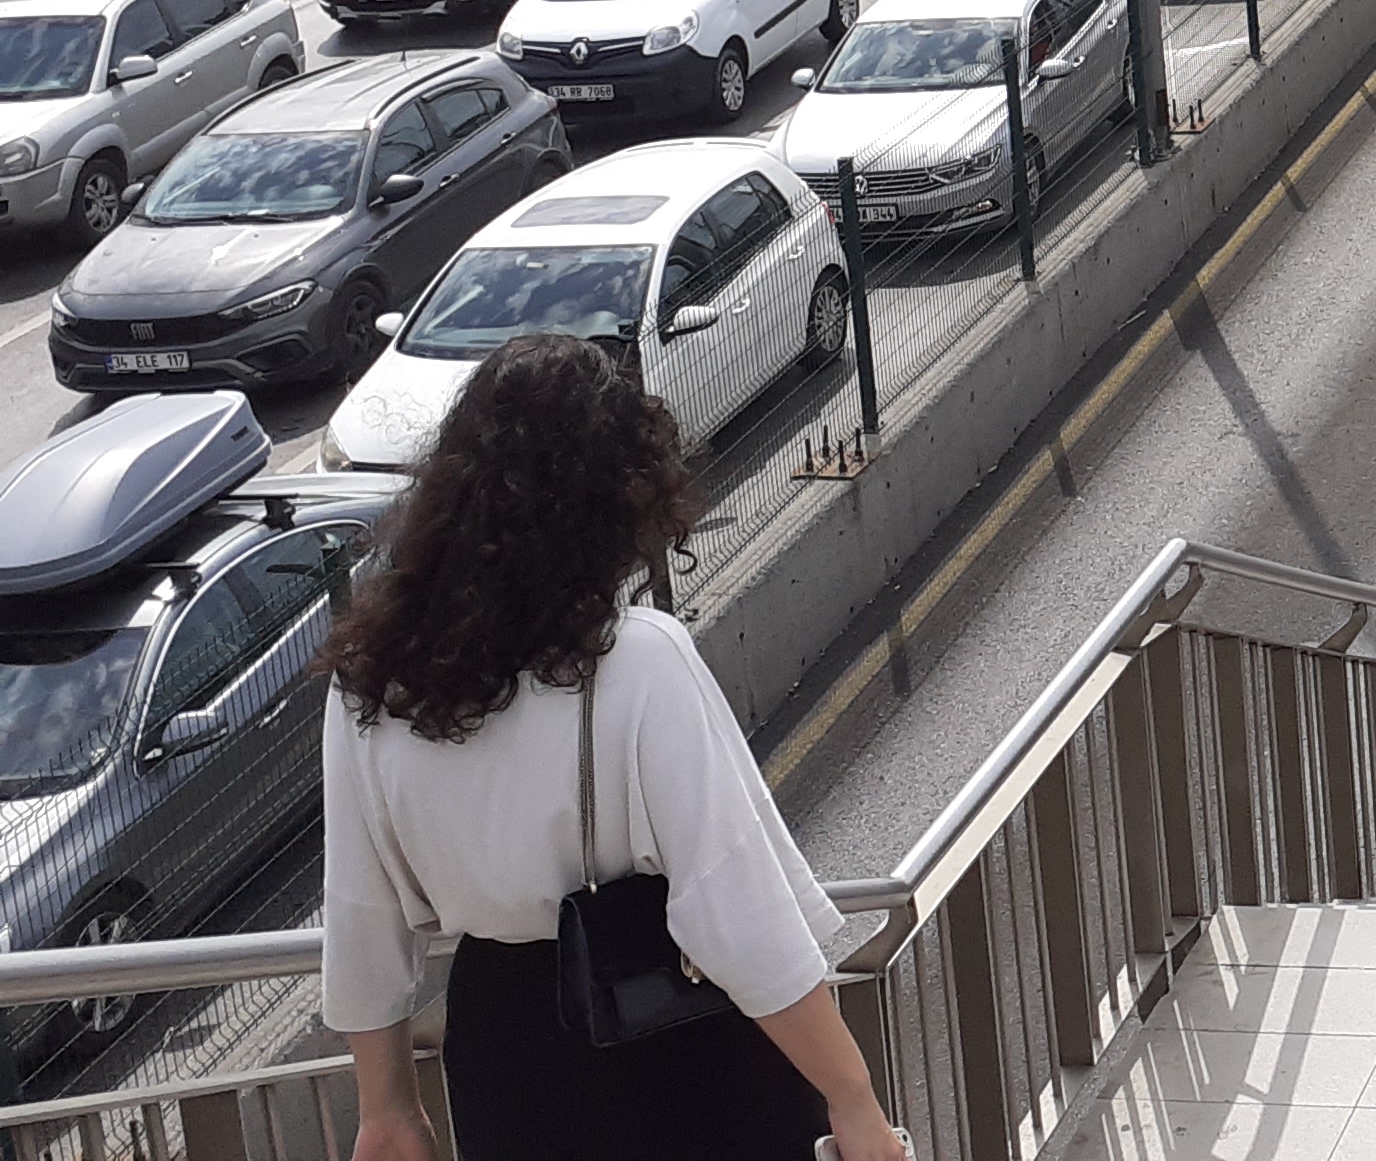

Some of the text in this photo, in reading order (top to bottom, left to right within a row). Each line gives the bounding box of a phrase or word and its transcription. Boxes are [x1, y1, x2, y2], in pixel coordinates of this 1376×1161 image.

[114, 353, 185, 369] 34 ELE 117
